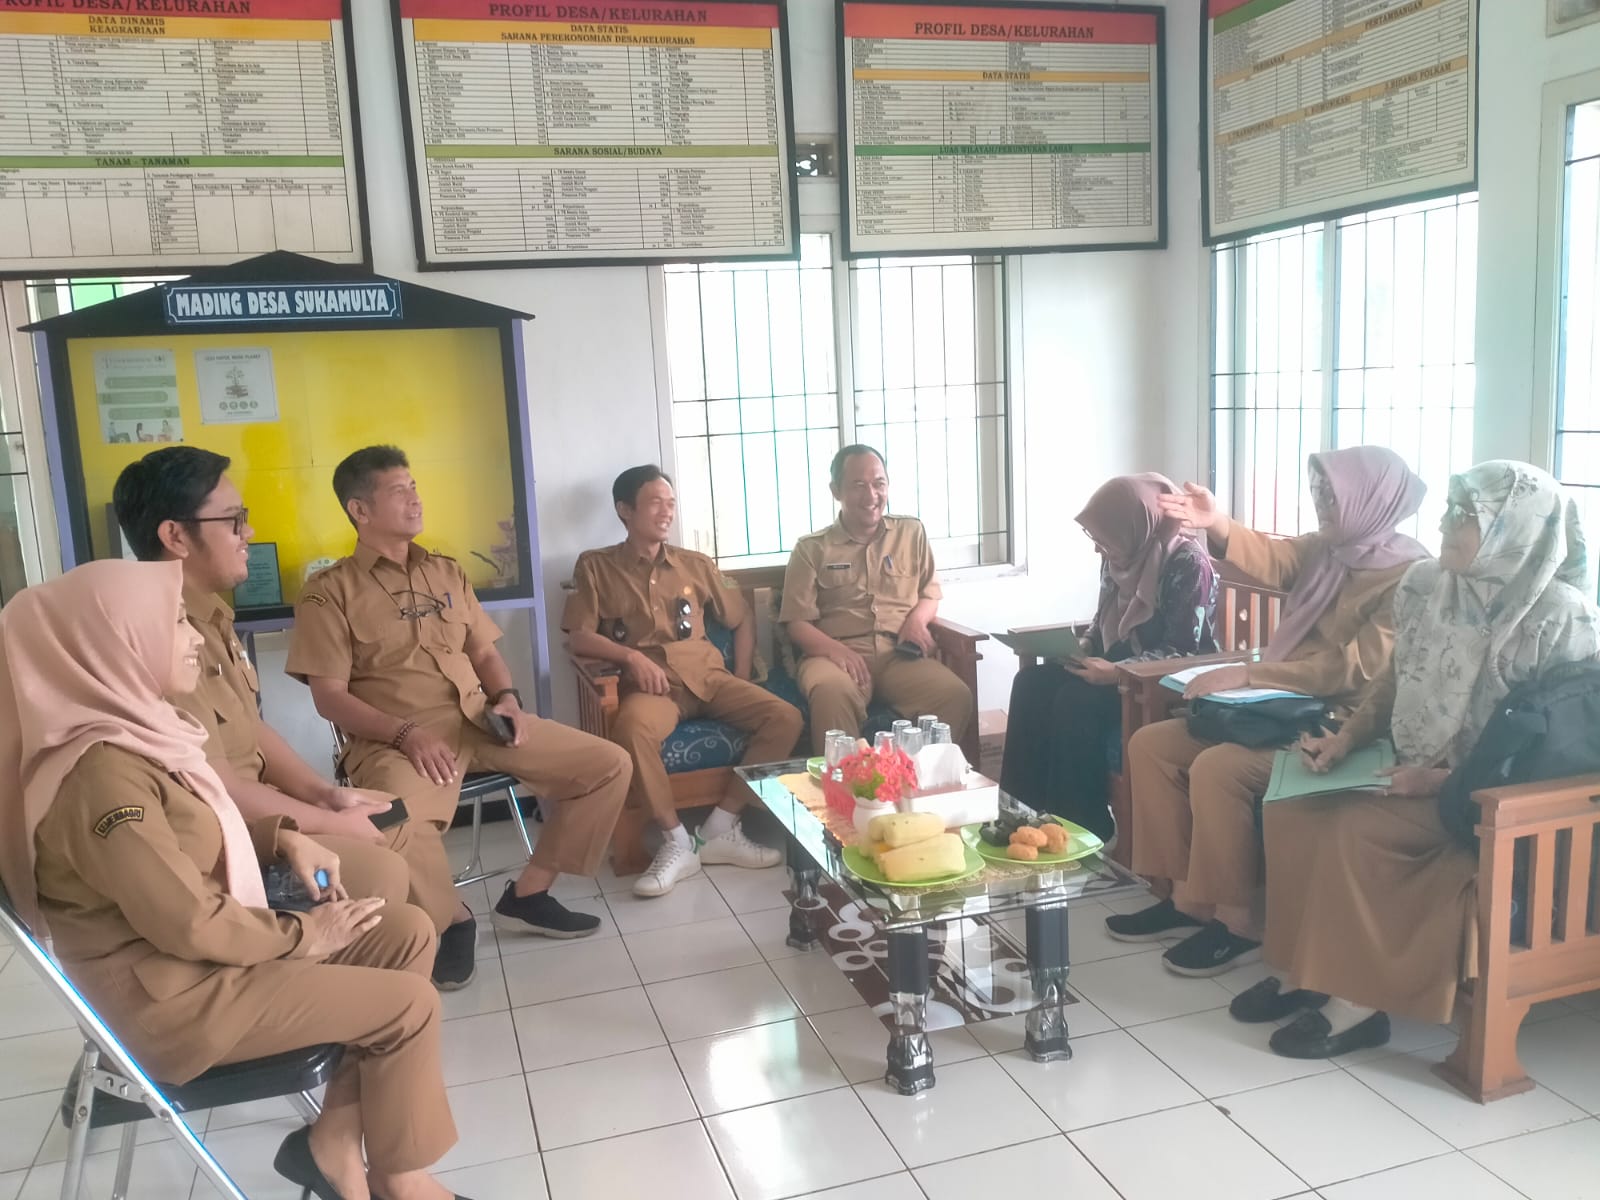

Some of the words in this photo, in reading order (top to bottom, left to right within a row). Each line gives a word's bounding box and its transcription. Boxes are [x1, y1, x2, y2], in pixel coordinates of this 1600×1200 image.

[3, 0, 65, 8] ROFIL
[72, 0, 251, 14] DESA/KELURAHAN
[489, 3, 551, 18] PROFIL
[556, 5, 708, 22] DESA/KELURAHAN
[88, 15, 117, 25] DATA
[120, 17, 165, 26] DINAMIS
[570, 24, 595, 33] DATA
[597, 25, 629, 34] STATIS
[914, 22, 967, 36] PROFIL
[970, 23, 1095, 39] DESA/KELURAHAN
[501, 32, 538, 41] SARANA
[615, 34, 696, 45] DESA/KELURAHAN
[982, 71, 1002, 80] DATA
[553, 147, 589, 156] SARANA
[592, 147, 663, 157] SOSIAL/BUDAYA
[95, 158, 132, 167] TANAM
[140, 157, 190, 166] TANAMAN
[175, 291, 243, 317] MADING
[247, 290, 291, 315] DESA
[294, 288, 390, 314] SUKAMULYA
